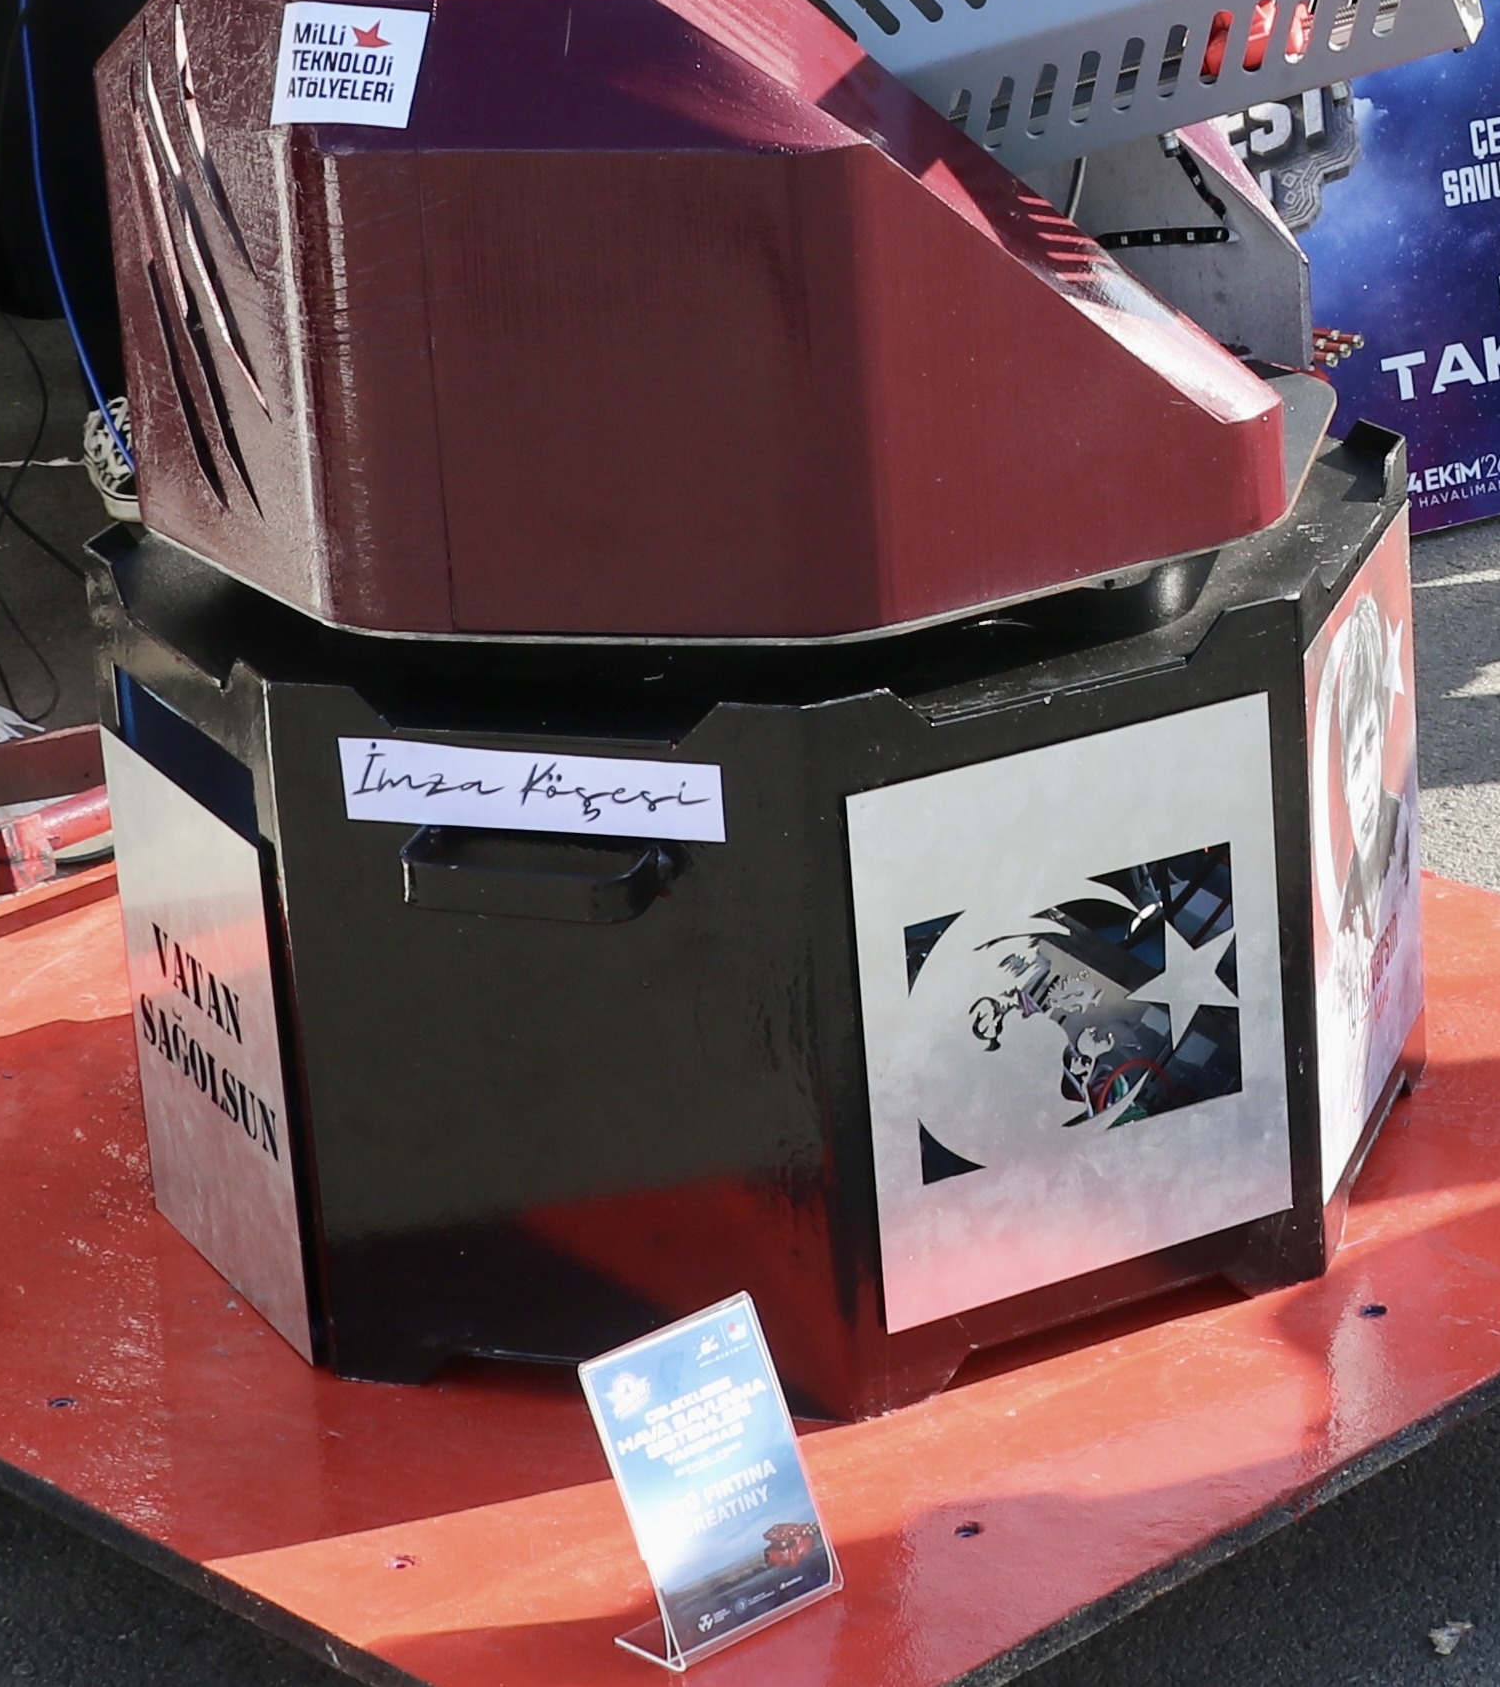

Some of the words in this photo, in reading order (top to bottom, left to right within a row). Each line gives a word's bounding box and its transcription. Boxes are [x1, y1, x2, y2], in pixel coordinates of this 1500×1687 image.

[293, 21, 347, 47] MİLLİ
[286, 76, 396, 104] ATÖLYELERİ
[291, 49, 394, 77] TEKNOLOJİ
[352, 741, 506, 799] İmza
[518, 762, 712, 823] Köşesi
[151, 922, 243, 1045] VATAN
[140, 993, 279, 1162] SAĞOLSUN
[617, 1421, 673, 1456] HAVA
[672, 1377, 768, 1432] SAVUNMA
[702, 1458, 778, 1505] FIRTINA
[684, 1483, 769, 1539] CREATINY
